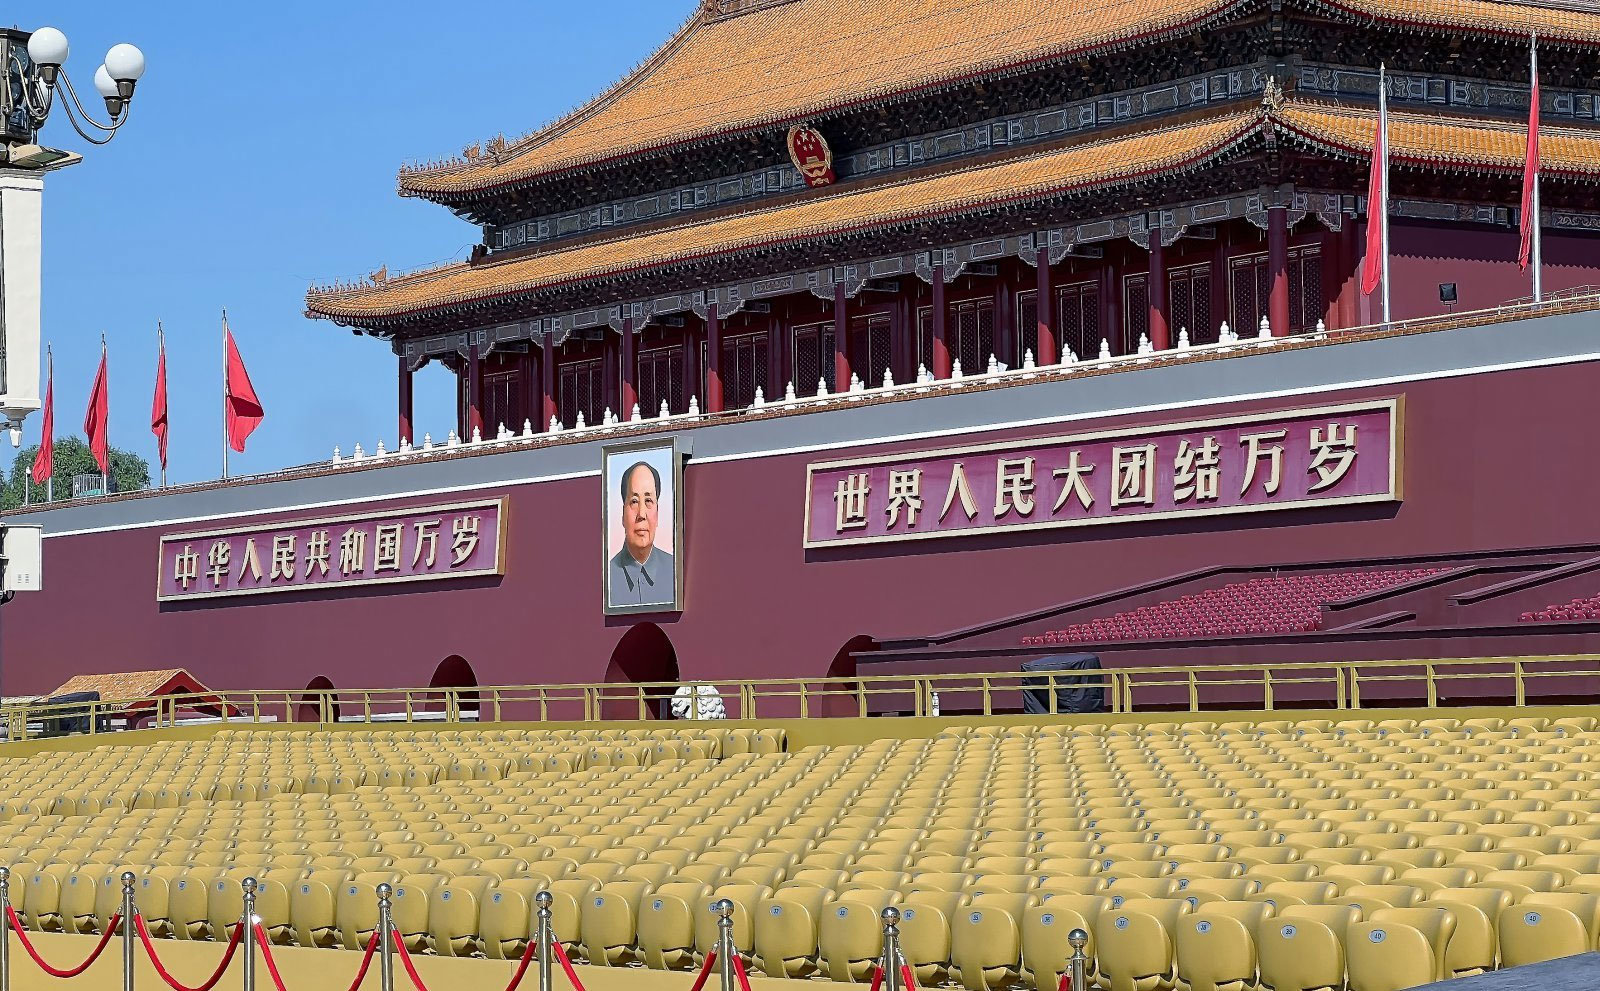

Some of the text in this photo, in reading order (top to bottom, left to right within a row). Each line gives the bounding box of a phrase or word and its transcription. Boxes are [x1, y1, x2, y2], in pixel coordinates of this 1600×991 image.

[833, 422, 1359, 532] 世界人民大团结万岁
[174, 516, 481, 589] 中华人民共和国万岁
